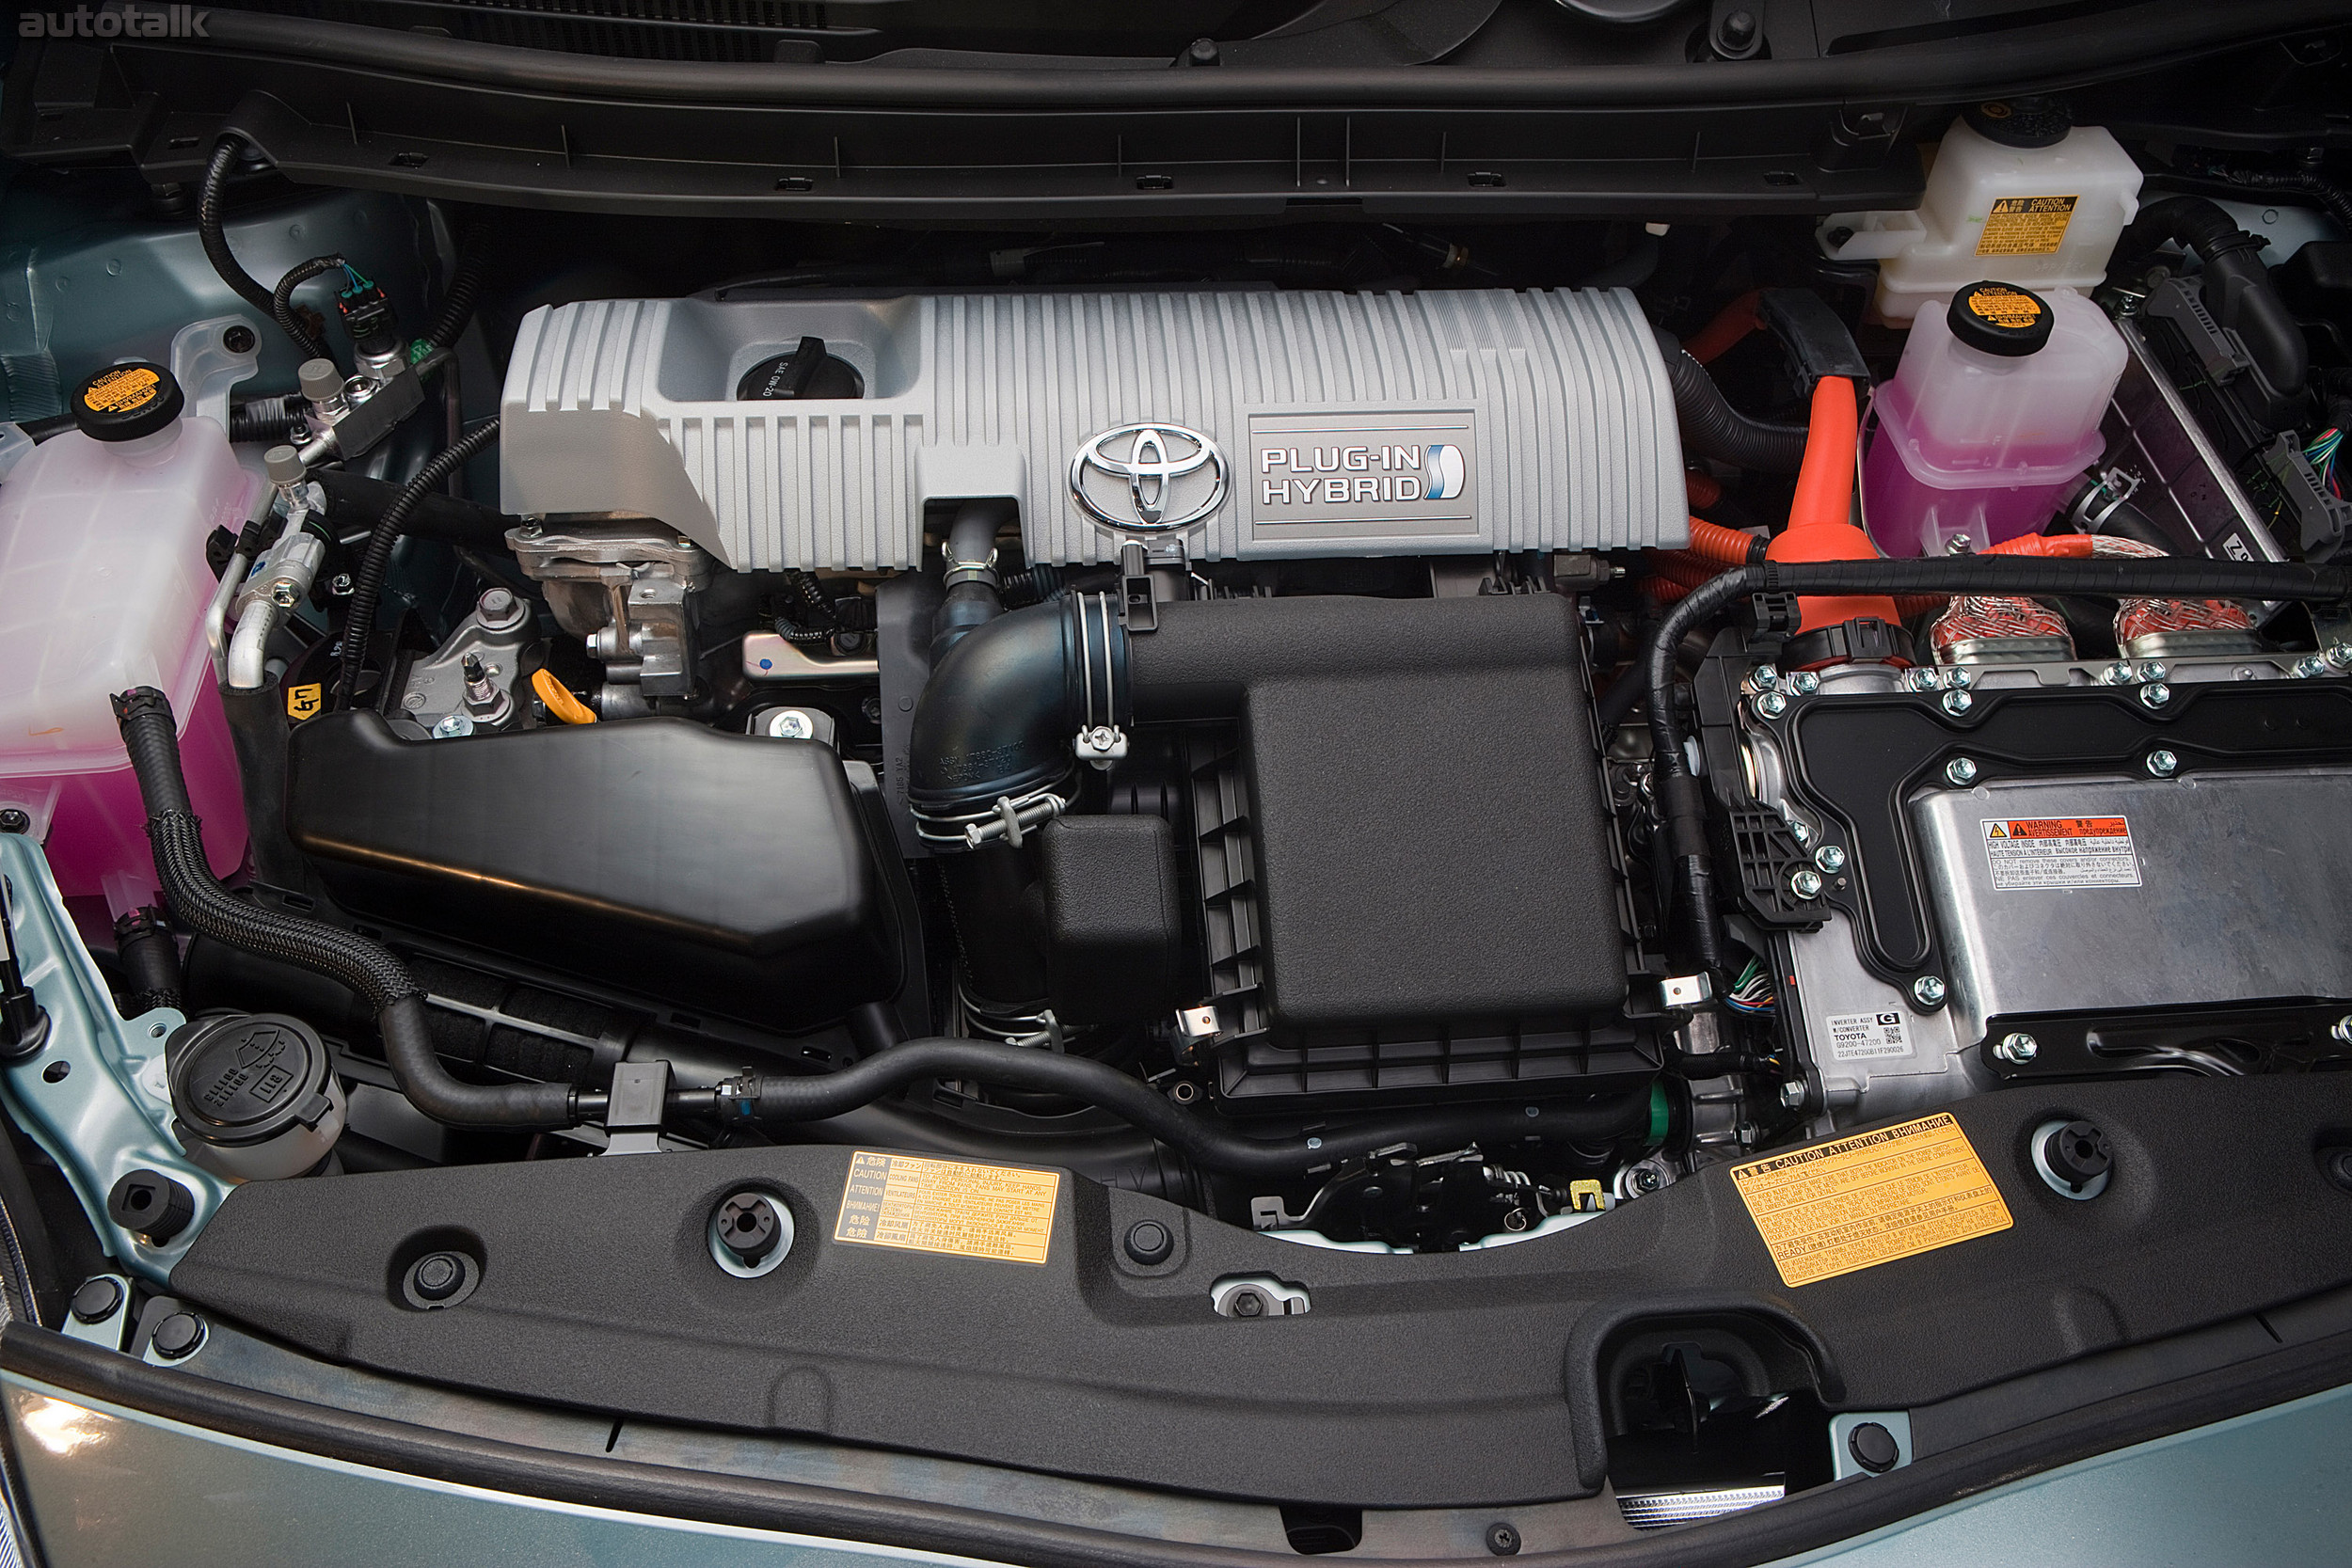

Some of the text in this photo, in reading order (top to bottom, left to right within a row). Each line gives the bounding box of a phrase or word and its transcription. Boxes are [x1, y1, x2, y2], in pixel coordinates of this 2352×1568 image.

[775, 362, 788, 374] SAE
[1261, 445, 1421, 473] PLUG-IN
[1262, 476, 1422, 504] HYBRID
[2027, 828, 2073, 837] AVERTISSEMENT
[2000, 840, 2020, 848] VOLTAGE
[1831, 1018, 1857, 1026] INVERTER
[1879, 1014, 1896, 1024] G
[1834, 1033, 1867, 1041] TOYOTA
[1836, 1038, 1882, 1049] G9200-47200
[1892, 1116, 1951, 1138] ВНИМАНИЕ
[1775, 1132, 1889, 1169] CAUTION ATTENTION
[853, 1168, 887, 1180] CAUTION
[1757, 1191, 1772, 1199] AVOID
[1790, 1180, 1809, 1191] PLEASE
[1809, 1177, 1823, 1186] MAKE
[1823, 1174, 1836, 1182] SURE
[1836, 1170, 1850, 1179] THAT
[1850, 1166, 1863, 1176] BOTH
[1874, 1158, 1898, 1168] INDICATOR
[1906, 1152, 1916, 1161] THE
[1916, 1148, 1933, 1158] POWER
[1932, 1144, 1951, 1153] SWITCH
[1752, 1199, 1763, 1208] AND
[1773, 1193, 1790, 1202] READY
[1790, 1189, 1804, 1197] LAMP
[1823, 1180, 1839, 1189] METER
[1861, 1169, 1879, 1179] BEFORE
[1879, 1164, 1899, 1174] WORKING
[1916, 1155, 1933, 1164] ENGINE
[850, 1184, 883, 1196] ATTENTION
[885, 1190, 915, 1199] VENTILATEURS
[1787, 1196, 1806, 1205] MANUAL
[1777, 1245, 1808, 1259] READY
